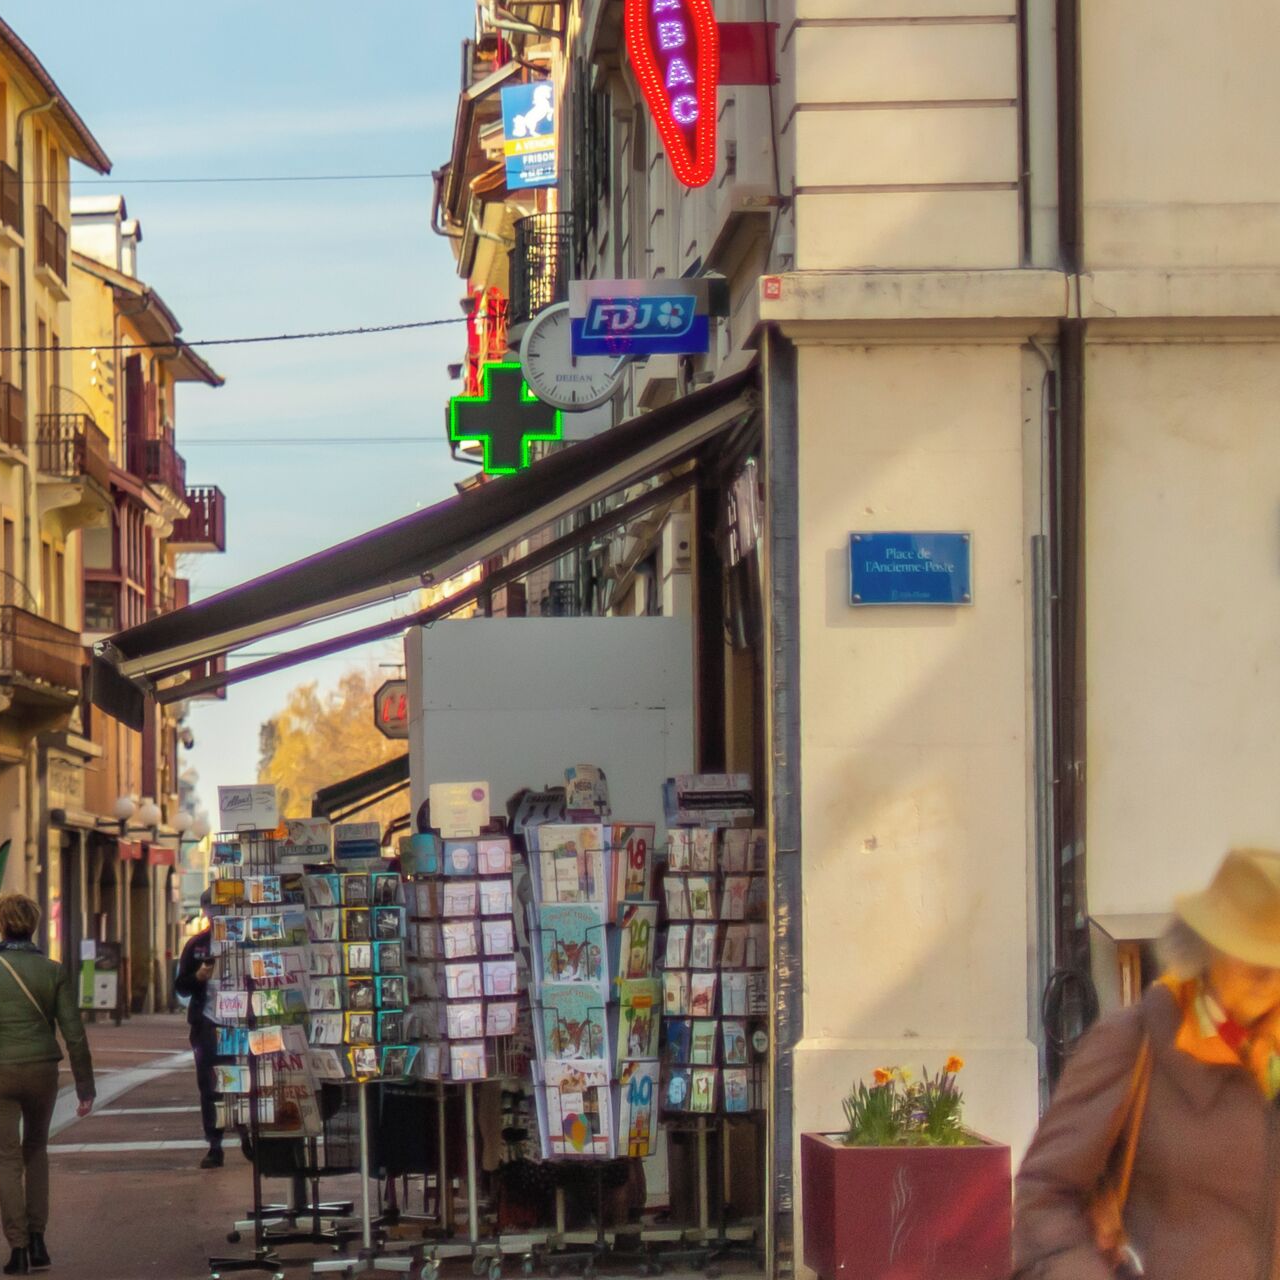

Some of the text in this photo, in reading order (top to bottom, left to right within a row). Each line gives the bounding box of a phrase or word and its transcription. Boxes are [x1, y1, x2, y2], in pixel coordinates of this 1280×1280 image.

[591, 304, 653, 330] FDJ
[556, 374, 593, 383] DEJEAN
[886, 547, 931, 560] Place de
[626, 838, 647, 870] 18
[219, 999, 244, 1010] EVIAN
